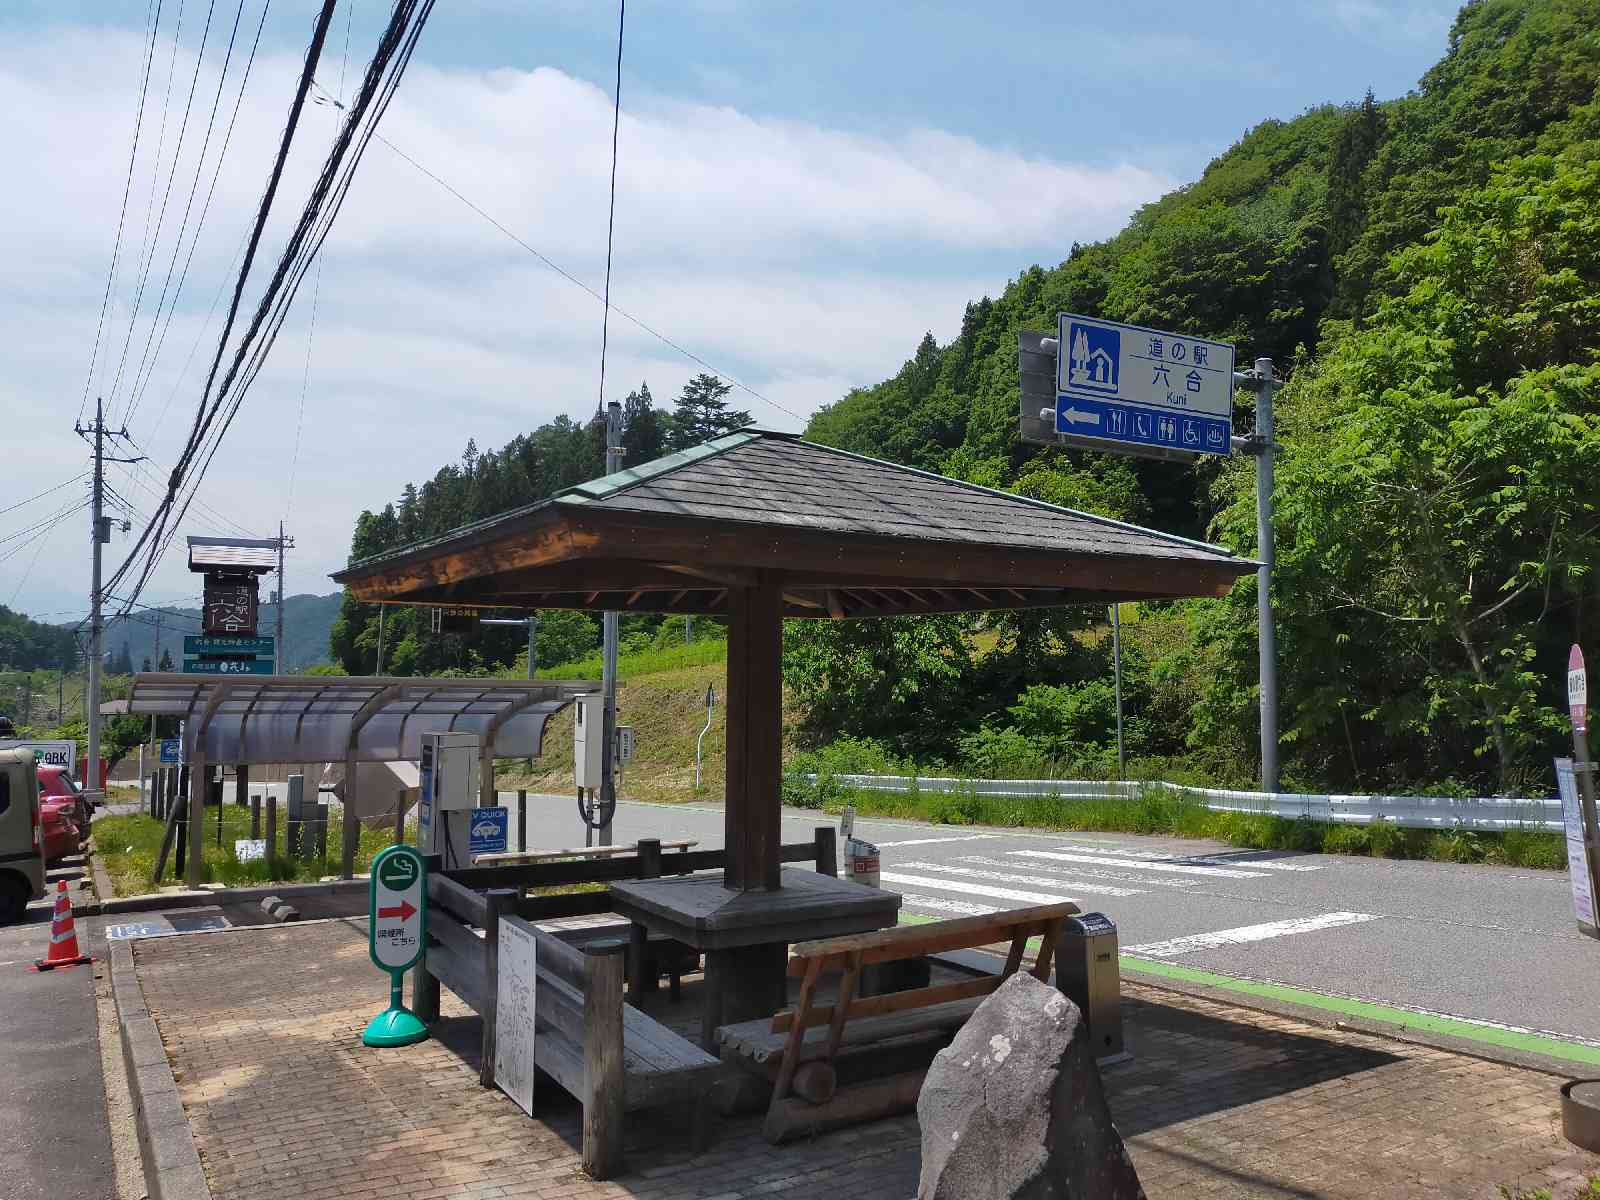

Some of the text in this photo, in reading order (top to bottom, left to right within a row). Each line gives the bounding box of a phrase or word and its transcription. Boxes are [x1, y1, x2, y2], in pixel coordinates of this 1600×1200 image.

[1149, 338, 1208, 366] 道の駅
[1152, 364, 1203, 393] 六合
[1166, 392, 1187, 406] Kuni
[235, 585, 249, 615] 道の駅
[377, 927, 405, 940] 喫煙所
[391, 937, 416, 946] こちら
